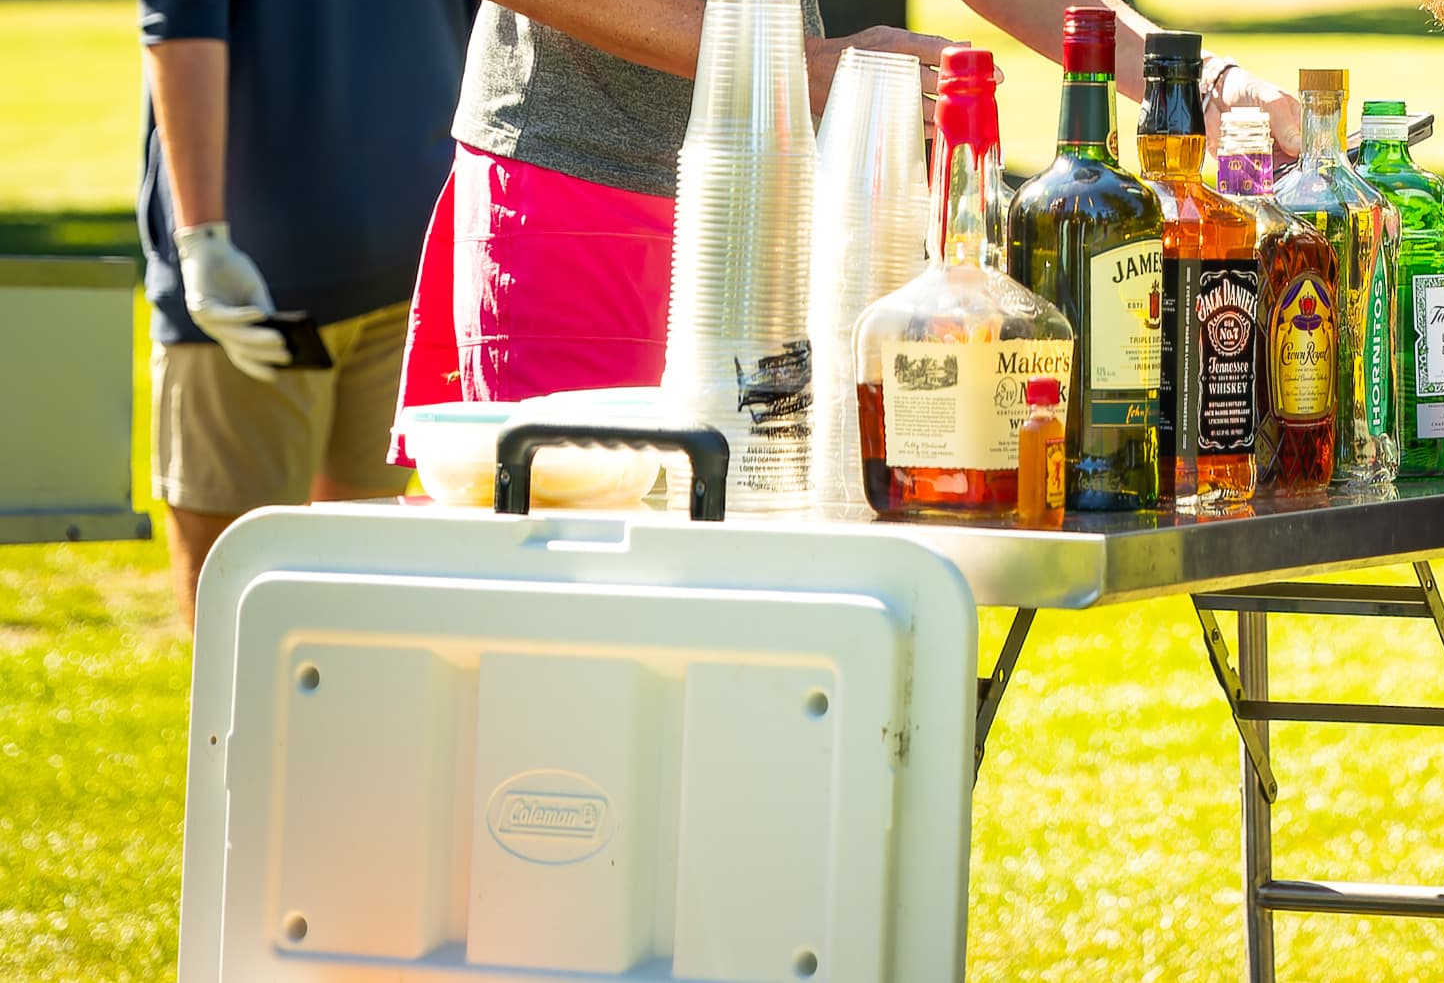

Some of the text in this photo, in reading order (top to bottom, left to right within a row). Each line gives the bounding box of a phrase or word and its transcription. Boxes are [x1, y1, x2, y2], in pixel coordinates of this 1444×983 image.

[1195, 285, 1223, 322] JACK
[995, 352, 1070, 374] Maker's
[1208, 357, 1249, 374] Tennessee
[1281, 341, 1330, 366] Crown Royal
[1372, 280, 1383, 426] HORNITOS
[1208, 382, 1248, 395] WHISKEY
[512, 797, 578, 826] Coleman
